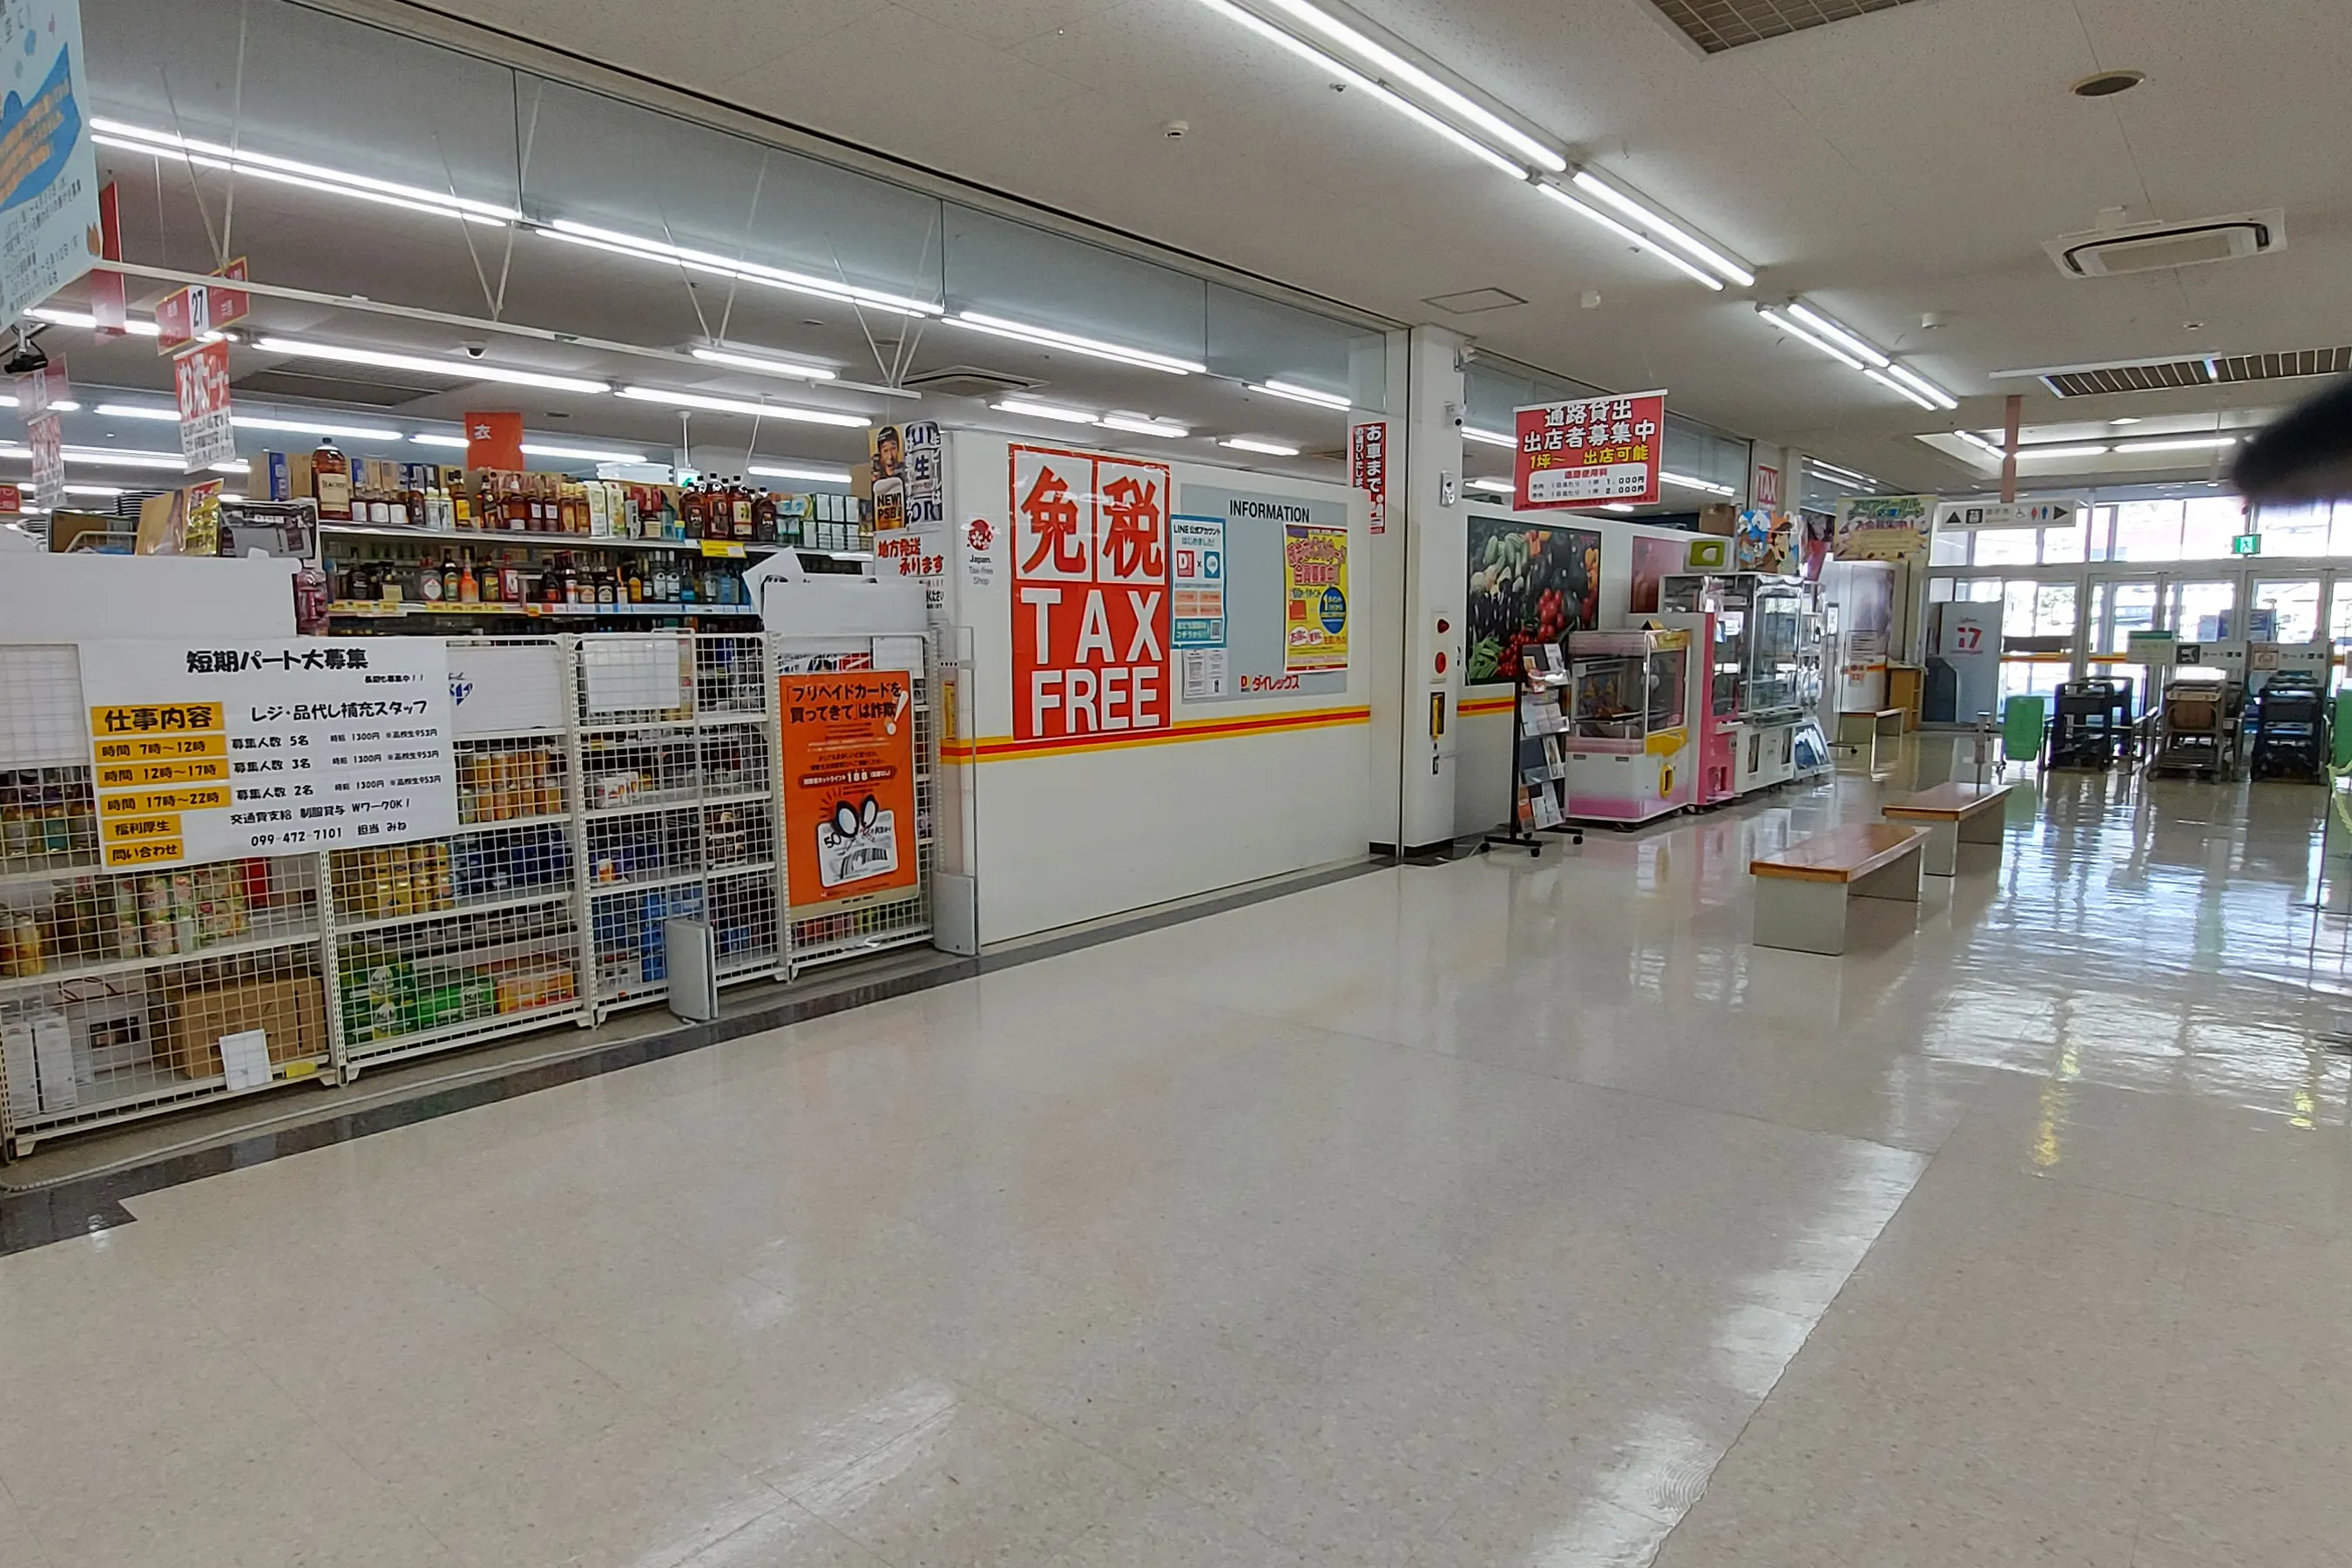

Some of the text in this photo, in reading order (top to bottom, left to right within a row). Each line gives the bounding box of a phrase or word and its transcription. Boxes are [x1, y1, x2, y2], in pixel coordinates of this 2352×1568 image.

[192, 289, 203, 328] 27
[1544, 399, 1632, 428] 通路貸出
[1524, 419, 1655, 453] 出店者募集中
[1366, 425, 1382, 493] お車まで
[1583, 445, 1649, 465] 出店可能
[1020, 464, 1164, 579] 免税
[1229, 499, 1310, 524] INFORMATION
[878, 537, 921, 558] 地方発送
[899, 554, 943, 576] 承ります
[972, 576, 990, 585] Shop
[1020, 587, 1164, 666] TAX
[186, 648, 369, 673] 短期パート大募集
[1252, 674, 1300, 692] ダイレックス
[1031, 666, 1160, 737] FREE
[105, 706, 213, 733] 仕事内容
[102, 744, 131, 757] 時間
[230, 736, 281, 750] 募集人数
[289, 734, 310, 747] 5名
[352, 732, 380, 741] 1300円
[233, 760, 284, 773] 募集人数
[292, 758, 311, 770] 3名
[354, 754, 382, 764] 1300円
[104, 768, 133, 782] 時間
[236, 787, 287, 801] 募集人数
[294, 784, 314, 797] 2名
[356, 780, 385, 790] 1300円
[107, 798, 137, 812] 時間
[230, 809, 293, 825] 交通費支給
[114, 820, 172, 836] 福利厚生
[251, 821, 408, 848] 099-472-7101 担当 みね
[112, 843, 179, 862] 問い合わせ
